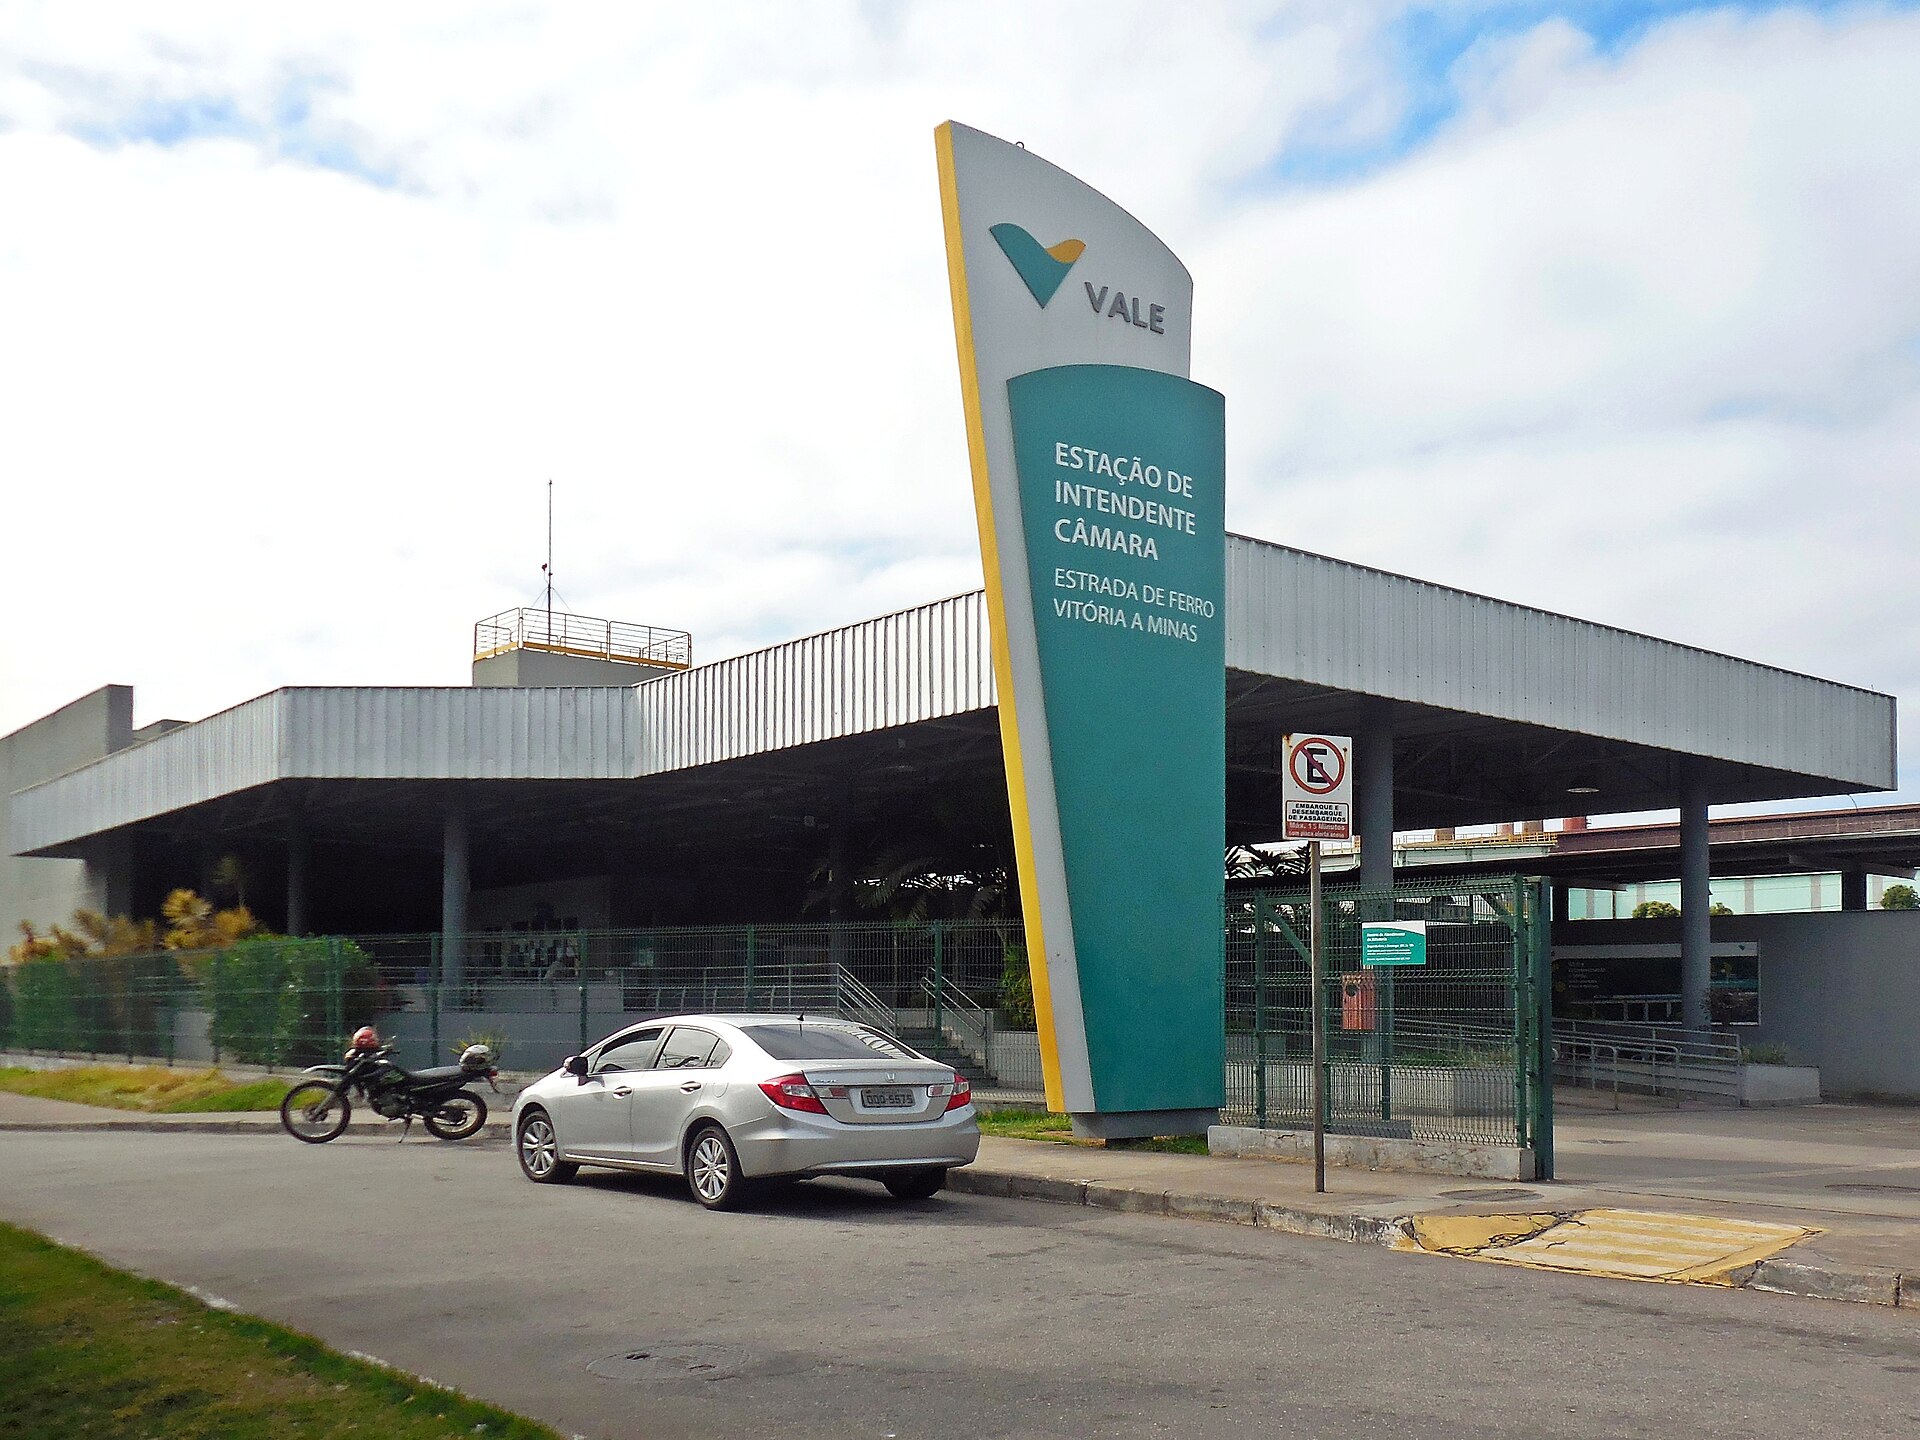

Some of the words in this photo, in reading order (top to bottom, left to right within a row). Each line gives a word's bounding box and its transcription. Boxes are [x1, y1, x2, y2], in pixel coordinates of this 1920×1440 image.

[1084, 281, 1165, 335] VALE
[1055, 442, 1161, 488] ESTAÇÃO
[1167, 470, 1193, 498] DE
[1055, 480, 1196, 535] INTENDENTE
[1054, 517, 1159, 560] CÂMARA
[1055, 568, 1138, 601] ESTRADA
[1143, 585, 1165, 606] DE
[1169, 591, 1215, 618] FERRO
[1053, 598, 1127, 628] VITÓRIA
[1131, 612, 1143, 631] A
[1147, 615, 1198, 642] MINAS
[1291, 808, 1342, 817] DESEMBARQUE
[1299, 815, 1346, 823] PASSAGEIROS
